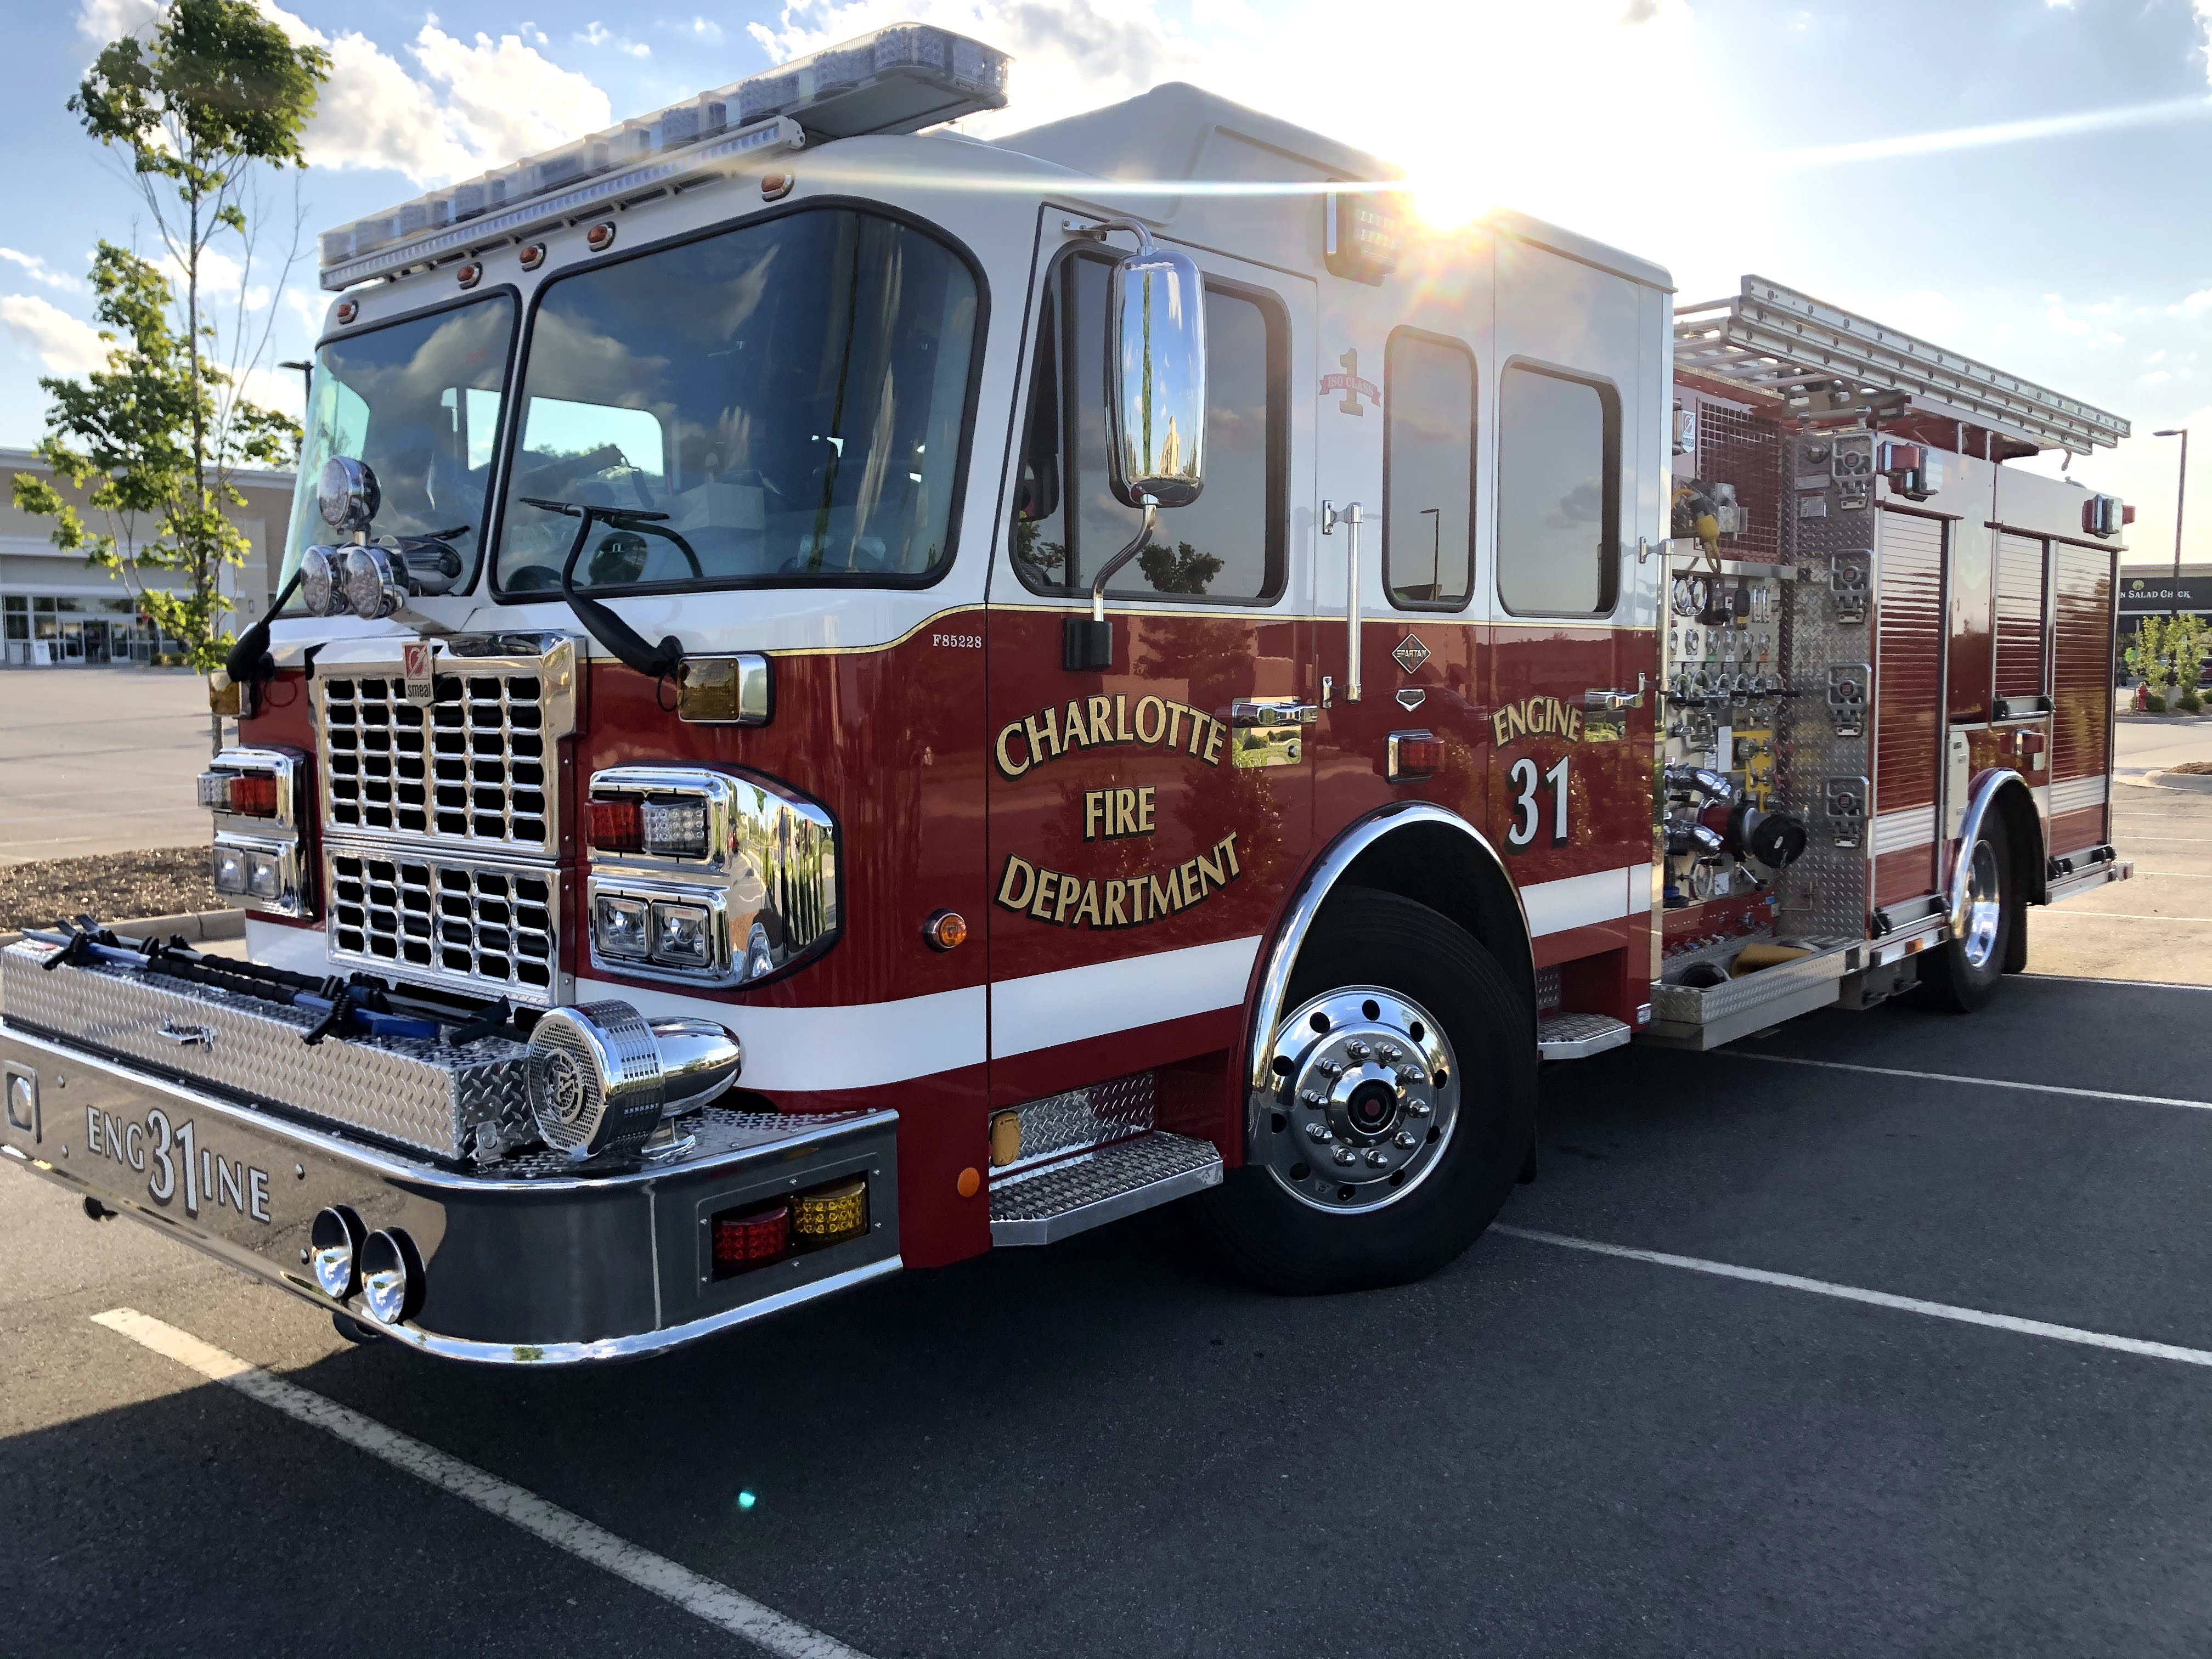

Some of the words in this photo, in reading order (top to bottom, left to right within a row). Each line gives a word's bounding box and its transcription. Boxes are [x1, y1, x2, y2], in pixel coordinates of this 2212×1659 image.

[1328, 376, 1344, 387] ISO
[1346, 376, 1374, 396] CLASS
[2160, 589, 2191, 599] CHCK
[933, 634, 981, 648] F85228
[1397, 650, 1427, 658] SPARTAN
[408, 683, 431, 698] smeal
[995, 693, 1227, 781] CHARLOTTE
[1492, 696, 1582, 750] ENGINE
[1084, 786, 1156, 842] FIRE
[1506, 755, 1569, 849] 31
[994, 830, 1240, 929] DEPARTMENT
[146, 1108, 199, 1219] 31
